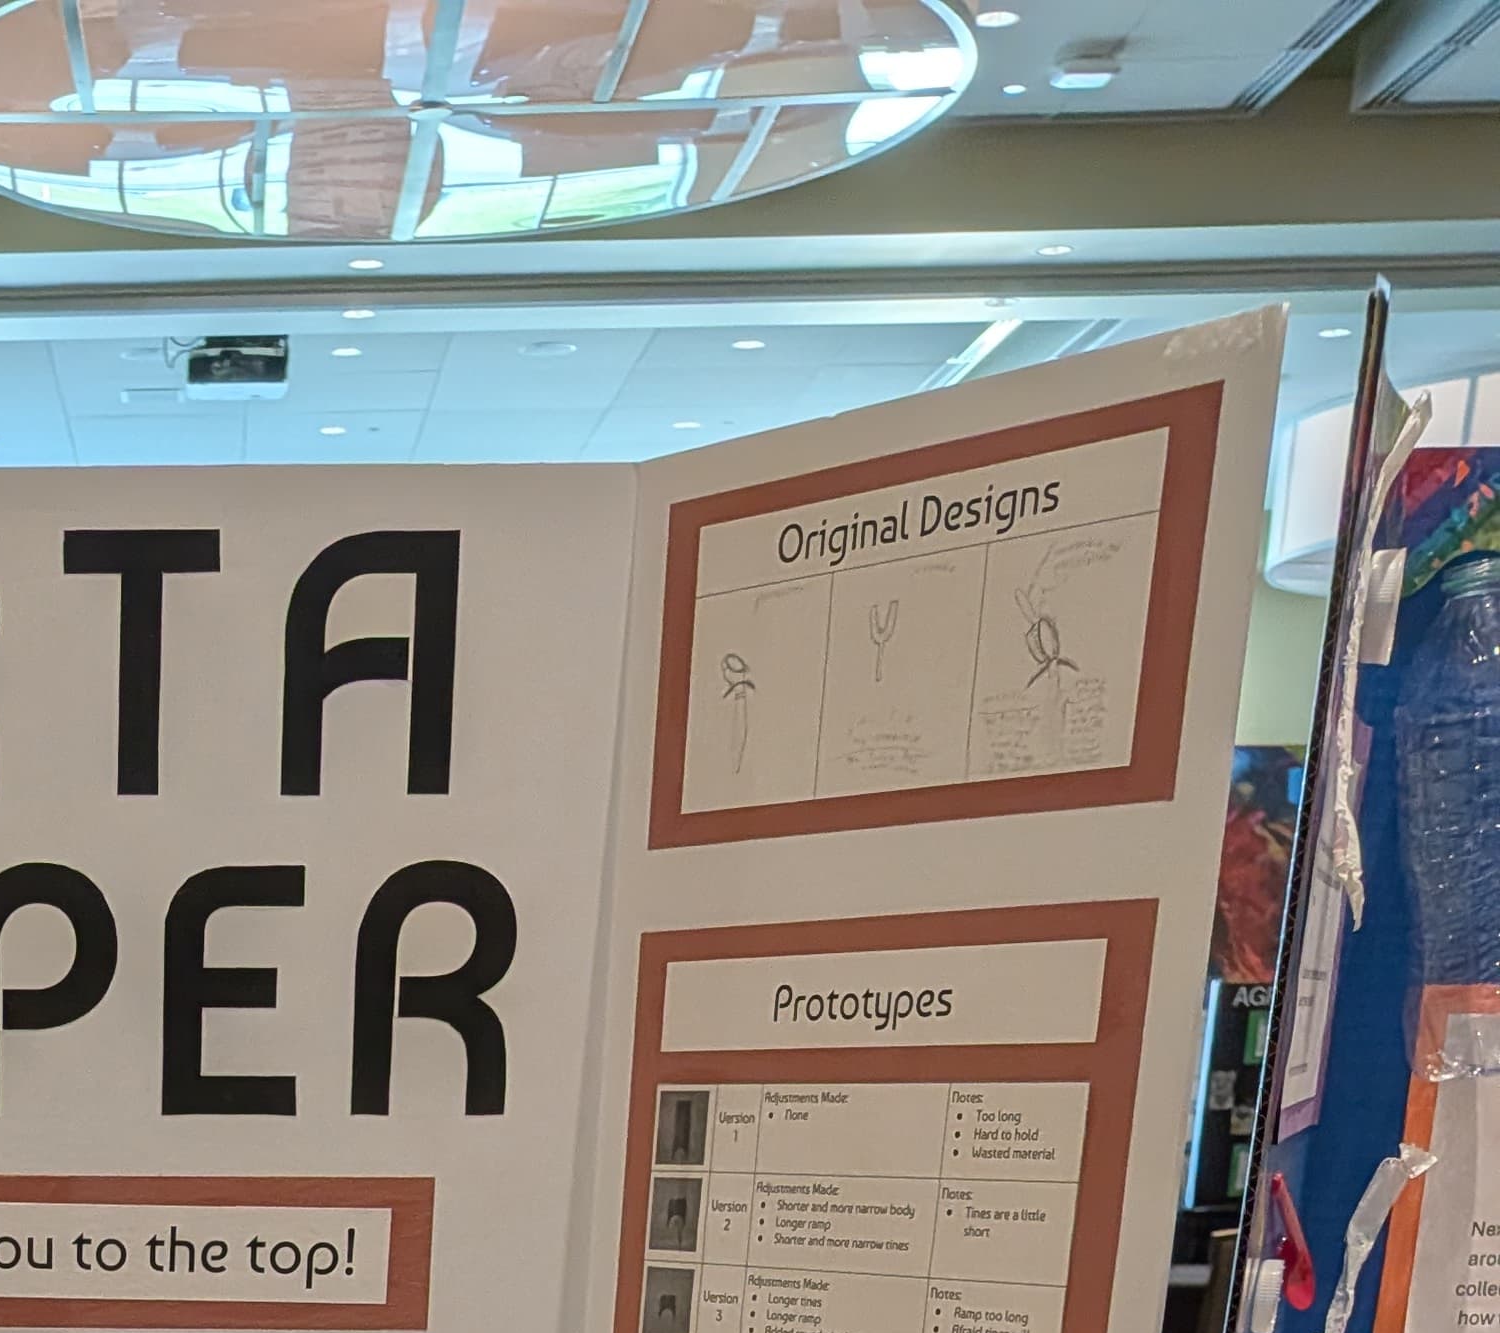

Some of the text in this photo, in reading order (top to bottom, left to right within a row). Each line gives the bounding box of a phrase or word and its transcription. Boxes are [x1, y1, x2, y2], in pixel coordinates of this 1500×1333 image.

[777, 481, 1061, 568] Original Designs
[773, 984, 954, 1032] Prototypes
[764, 1092, 819, 1105] Adjustments
[719, 1112, 756, 1125] Version
[785, 1110, 808, 1121] None
[976, 1110, 1022, 1125] Too long
[973, 1129, 1039, 1142] Hard to hold
[972, 1147, 1055, 1161] Wasted material
[71, 1231, 128, 1272] to
[144, 1225, 229, 1274] the
[244, 1227, 356, 1290] top!
[1458, 1311, 1496, 1326] how
